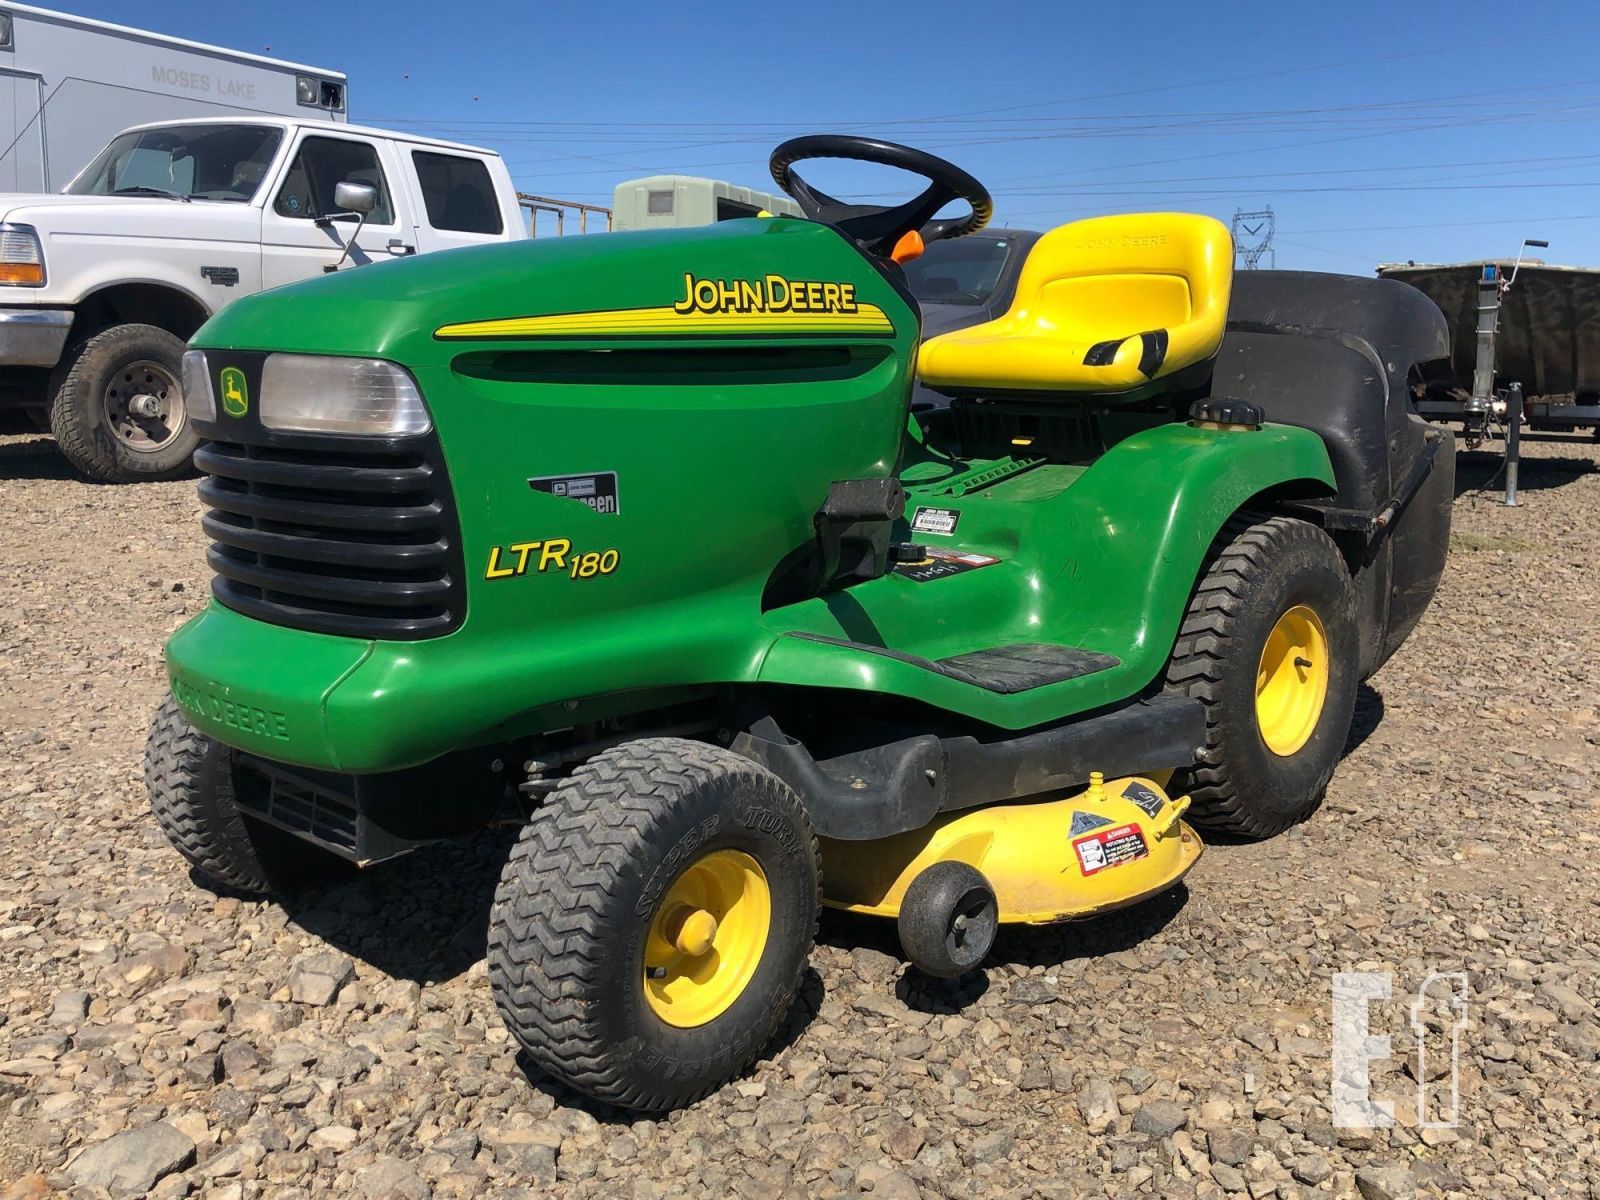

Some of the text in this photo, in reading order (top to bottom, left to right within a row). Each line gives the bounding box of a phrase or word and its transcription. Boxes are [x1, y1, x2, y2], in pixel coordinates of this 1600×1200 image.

[151, 65, 257, 100] MOSES LAKE
[1122, 234, 1168, 248] DEERE
[674, 273, 858, 313] JOHN DEERE
[485, 538, 619, 580] LTR 180
[207, 693, 290, 741] DEERE
[635, 814, 721, 920] SUPER
